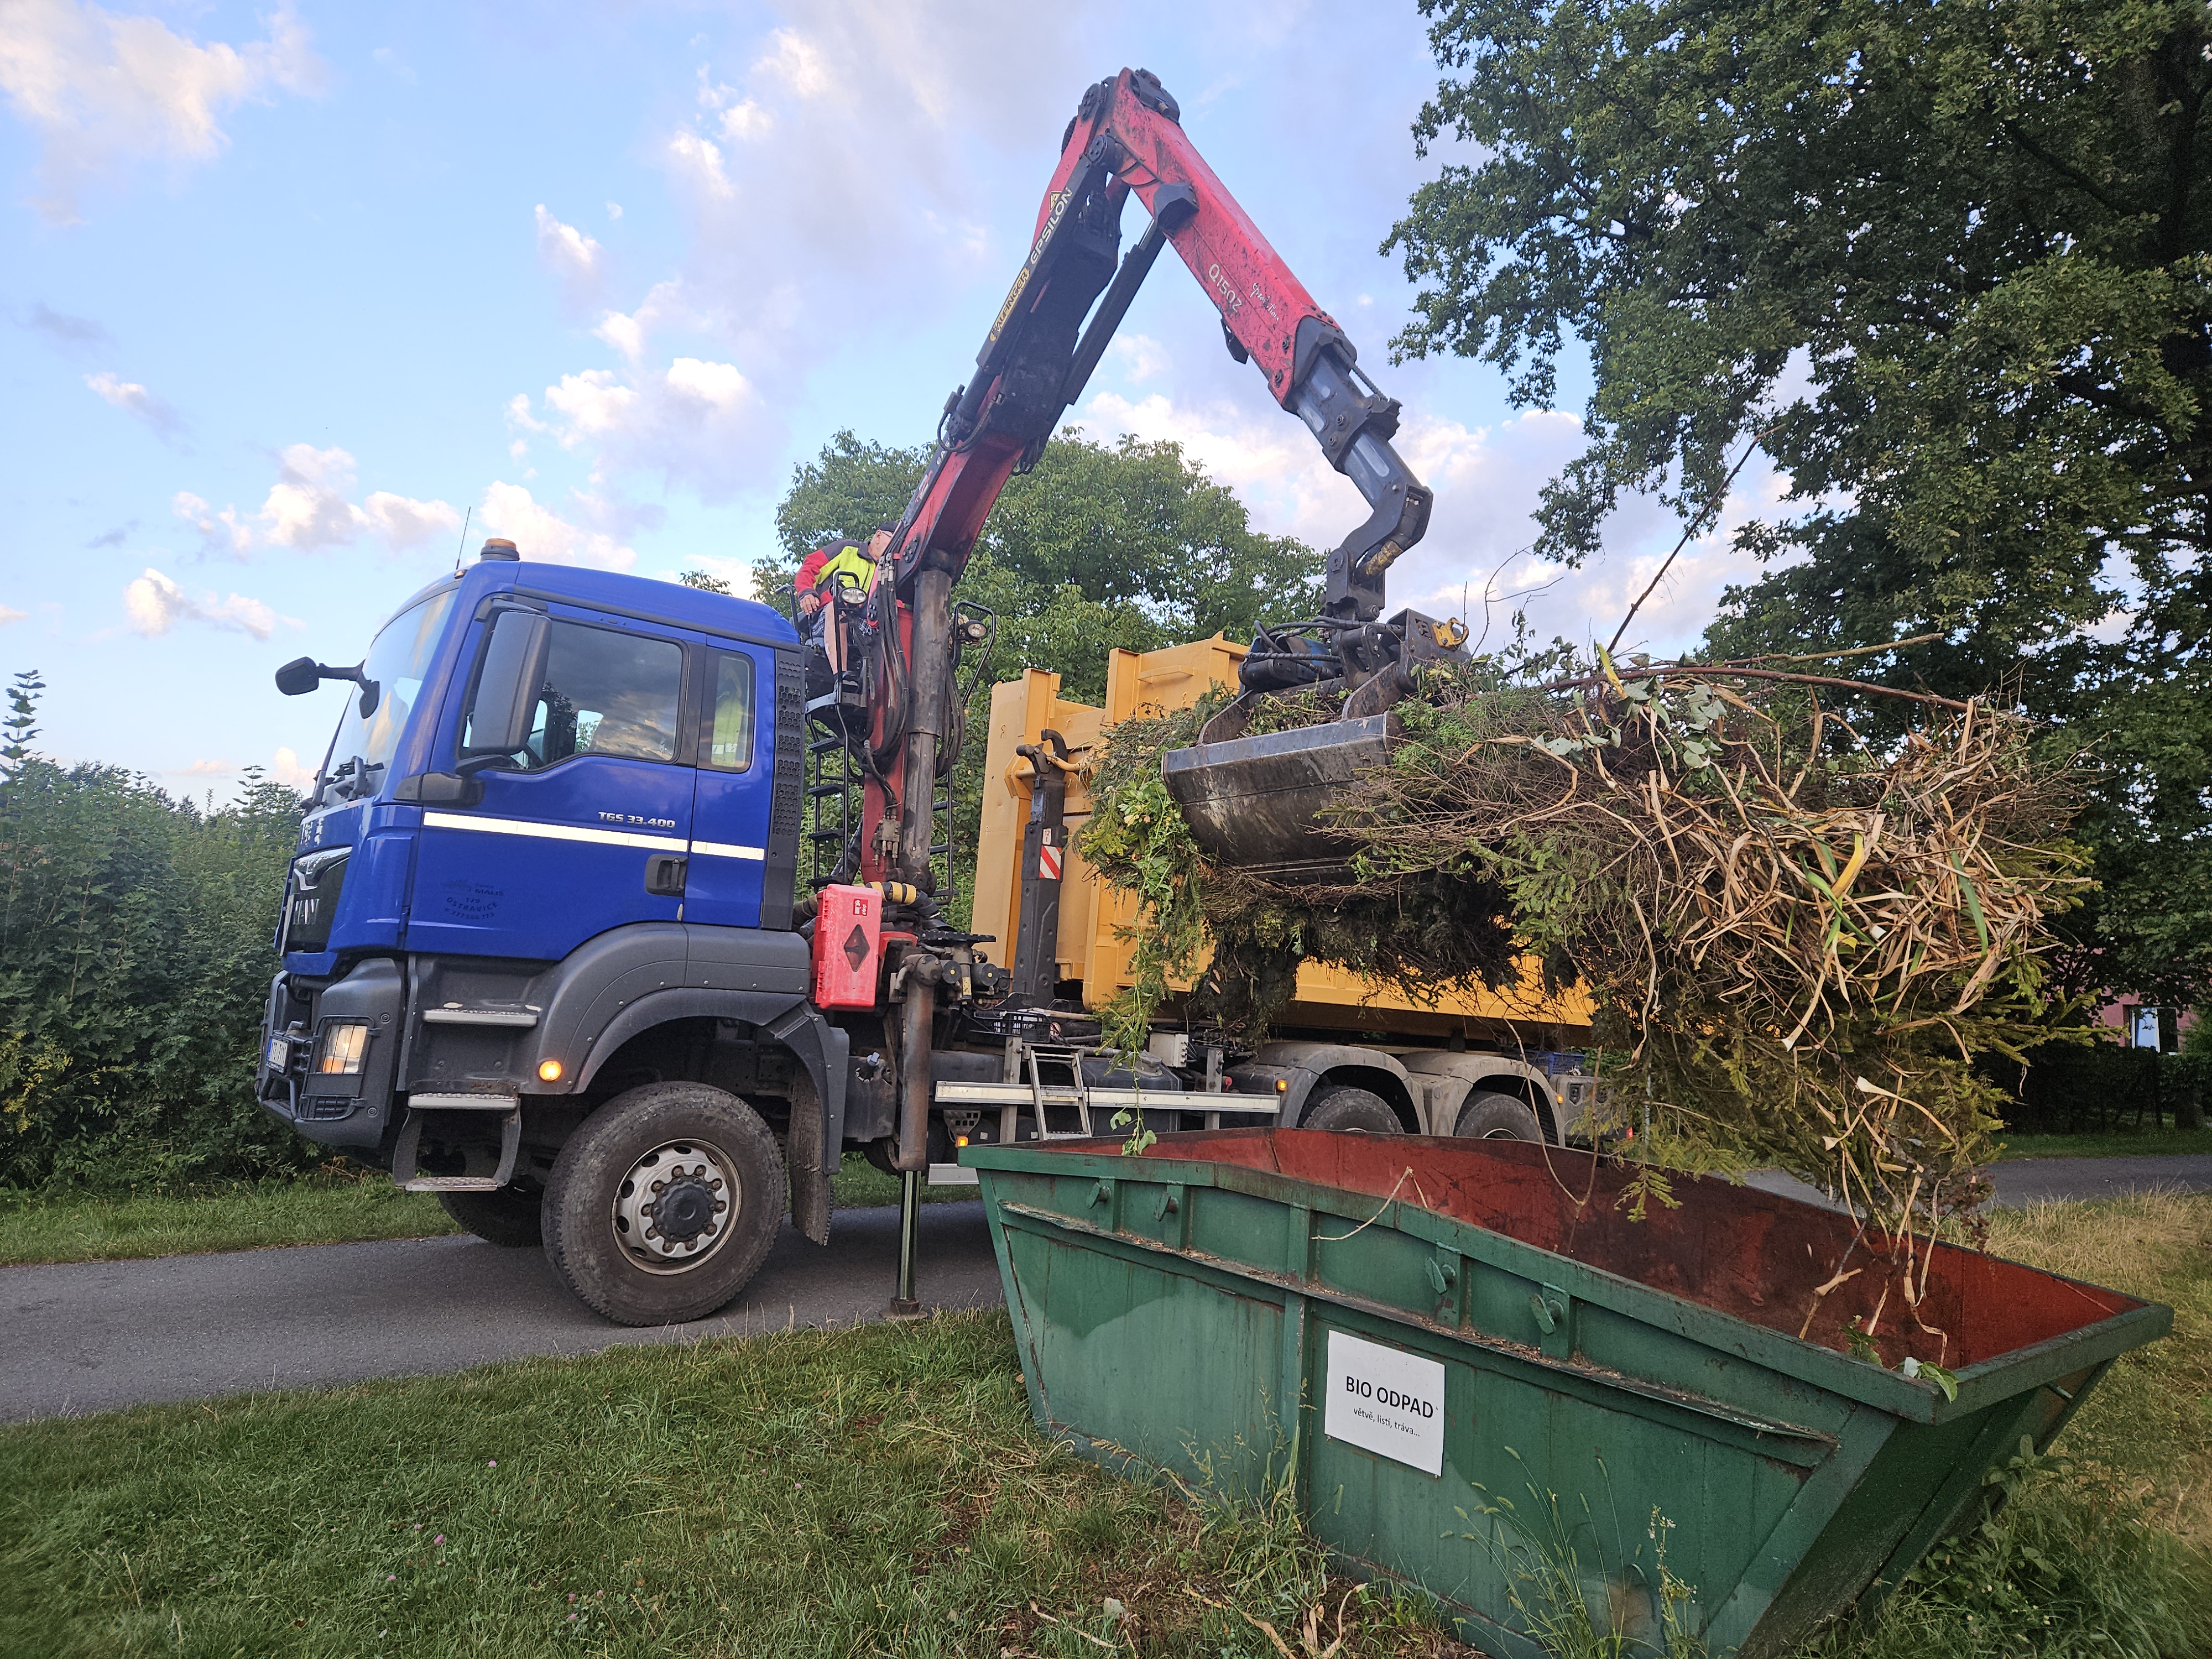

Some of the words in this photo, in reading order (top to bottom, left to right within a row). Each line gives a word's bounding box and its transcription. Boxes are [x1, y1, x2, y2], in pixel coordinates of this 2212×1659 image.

[1030, 186, 1073, 264] EPSILON
[992, 271, 1029, 335] ALFINGER
[1209, 263, 1242, 313] Q150Z
[598, 811, 624, 822] TGS
[627, 815, 676, 828] 33.400
[1346, 1375, 1372, 1398] BIO
[1376, 1387, 1433, 1418] ODPAD
[1353, 1407, 1375, 1423] větvě,
[1377, 1414, 1392, 1429] listí,
[1394, 1421, 1420, 1437] tráva...
